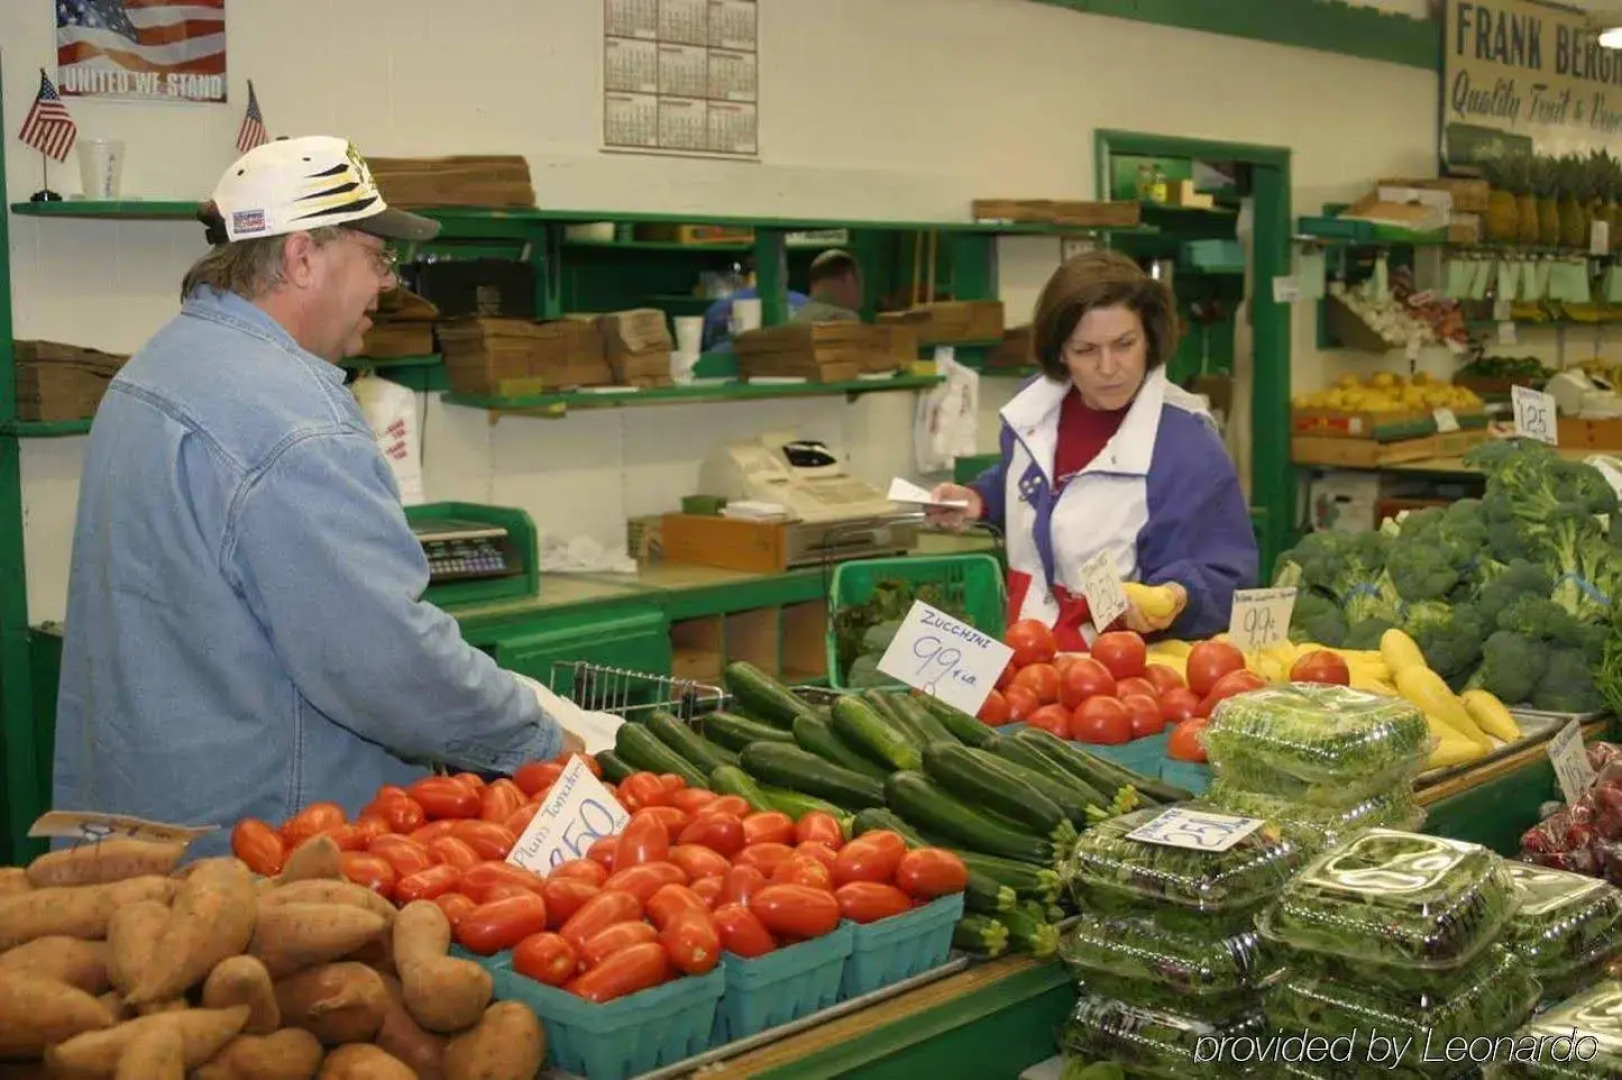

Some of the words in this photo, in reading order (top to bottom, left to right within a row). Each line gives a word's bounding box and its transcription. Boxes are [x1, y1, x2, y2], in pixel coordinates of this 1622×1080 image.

[1457, 3, 1542, 69] FRANK
[65, 66, 129, 93] UNITED
[135, 71, 162, 94] WE
[167, 72, 222, 98] STAND
[1453, 68, 1521, 127] Quality
[920, 609, 992, 649] ZUCCHINI
[513, 826, 551, 868] Plum
